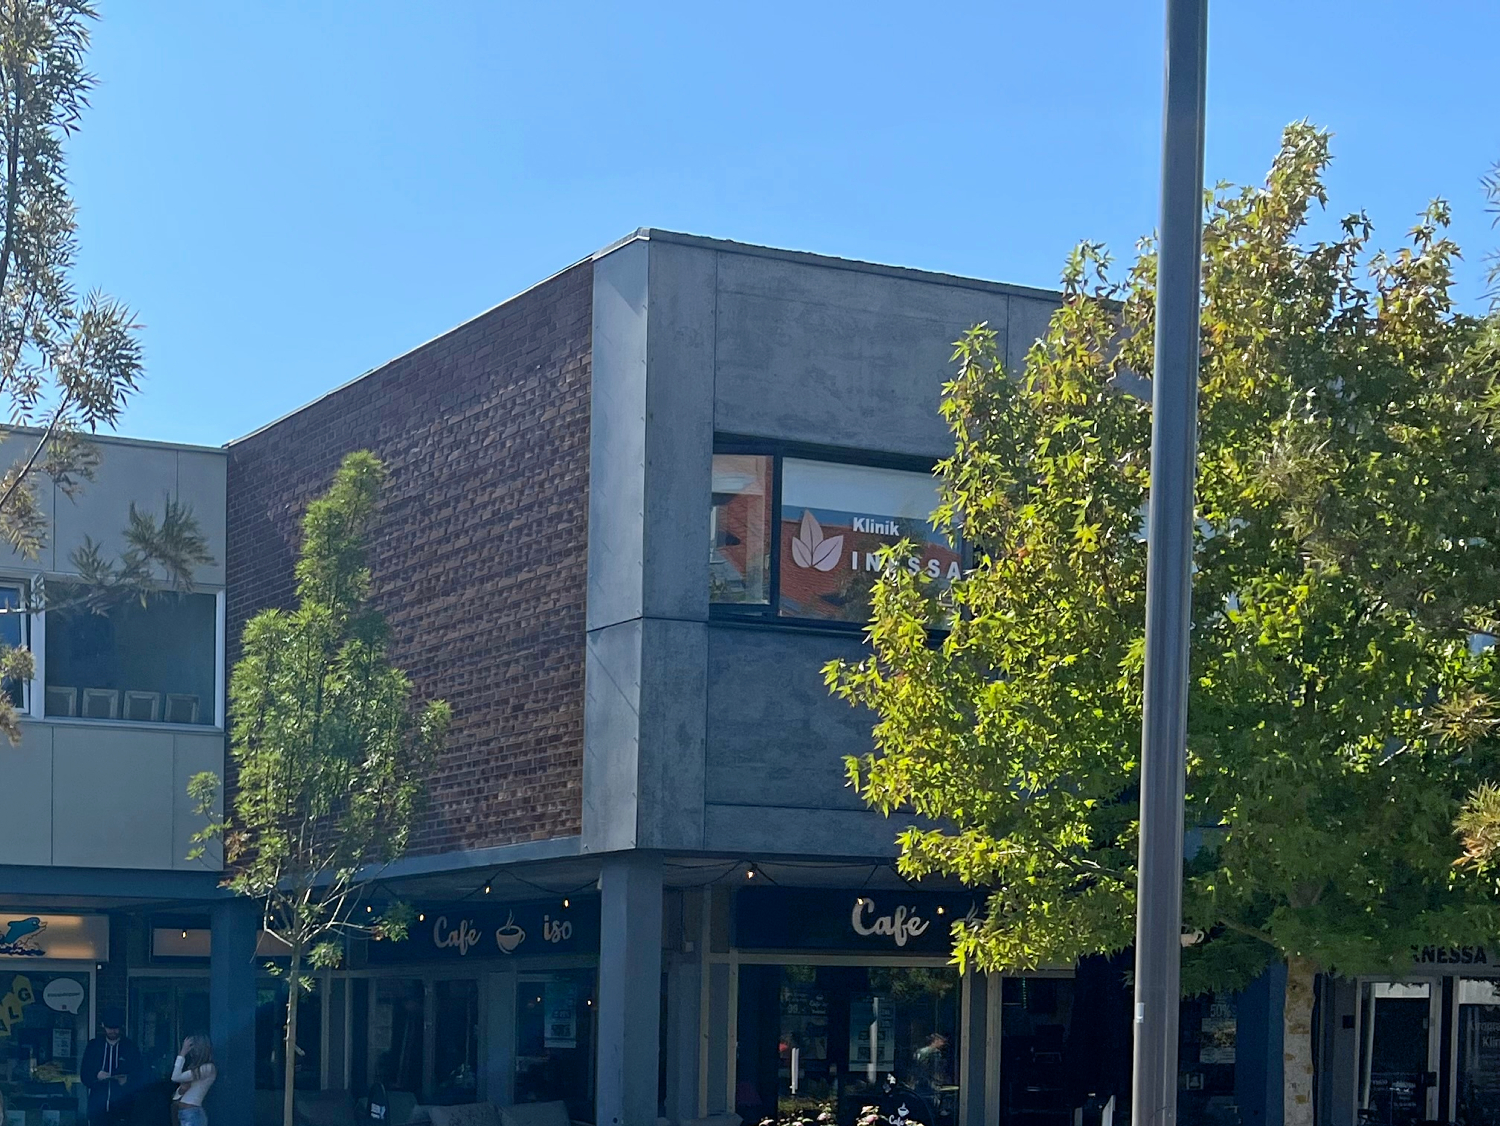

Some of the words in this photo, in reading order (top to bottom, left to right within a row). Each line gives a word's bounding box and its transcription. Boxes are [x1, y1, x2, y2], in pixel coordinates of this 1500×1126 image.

[853, 517, 900, 537] Klinik
[433, 915, 482, 956] Café
[543, 914, 573, 943] iso
[852, 897, 930, 947] Café
